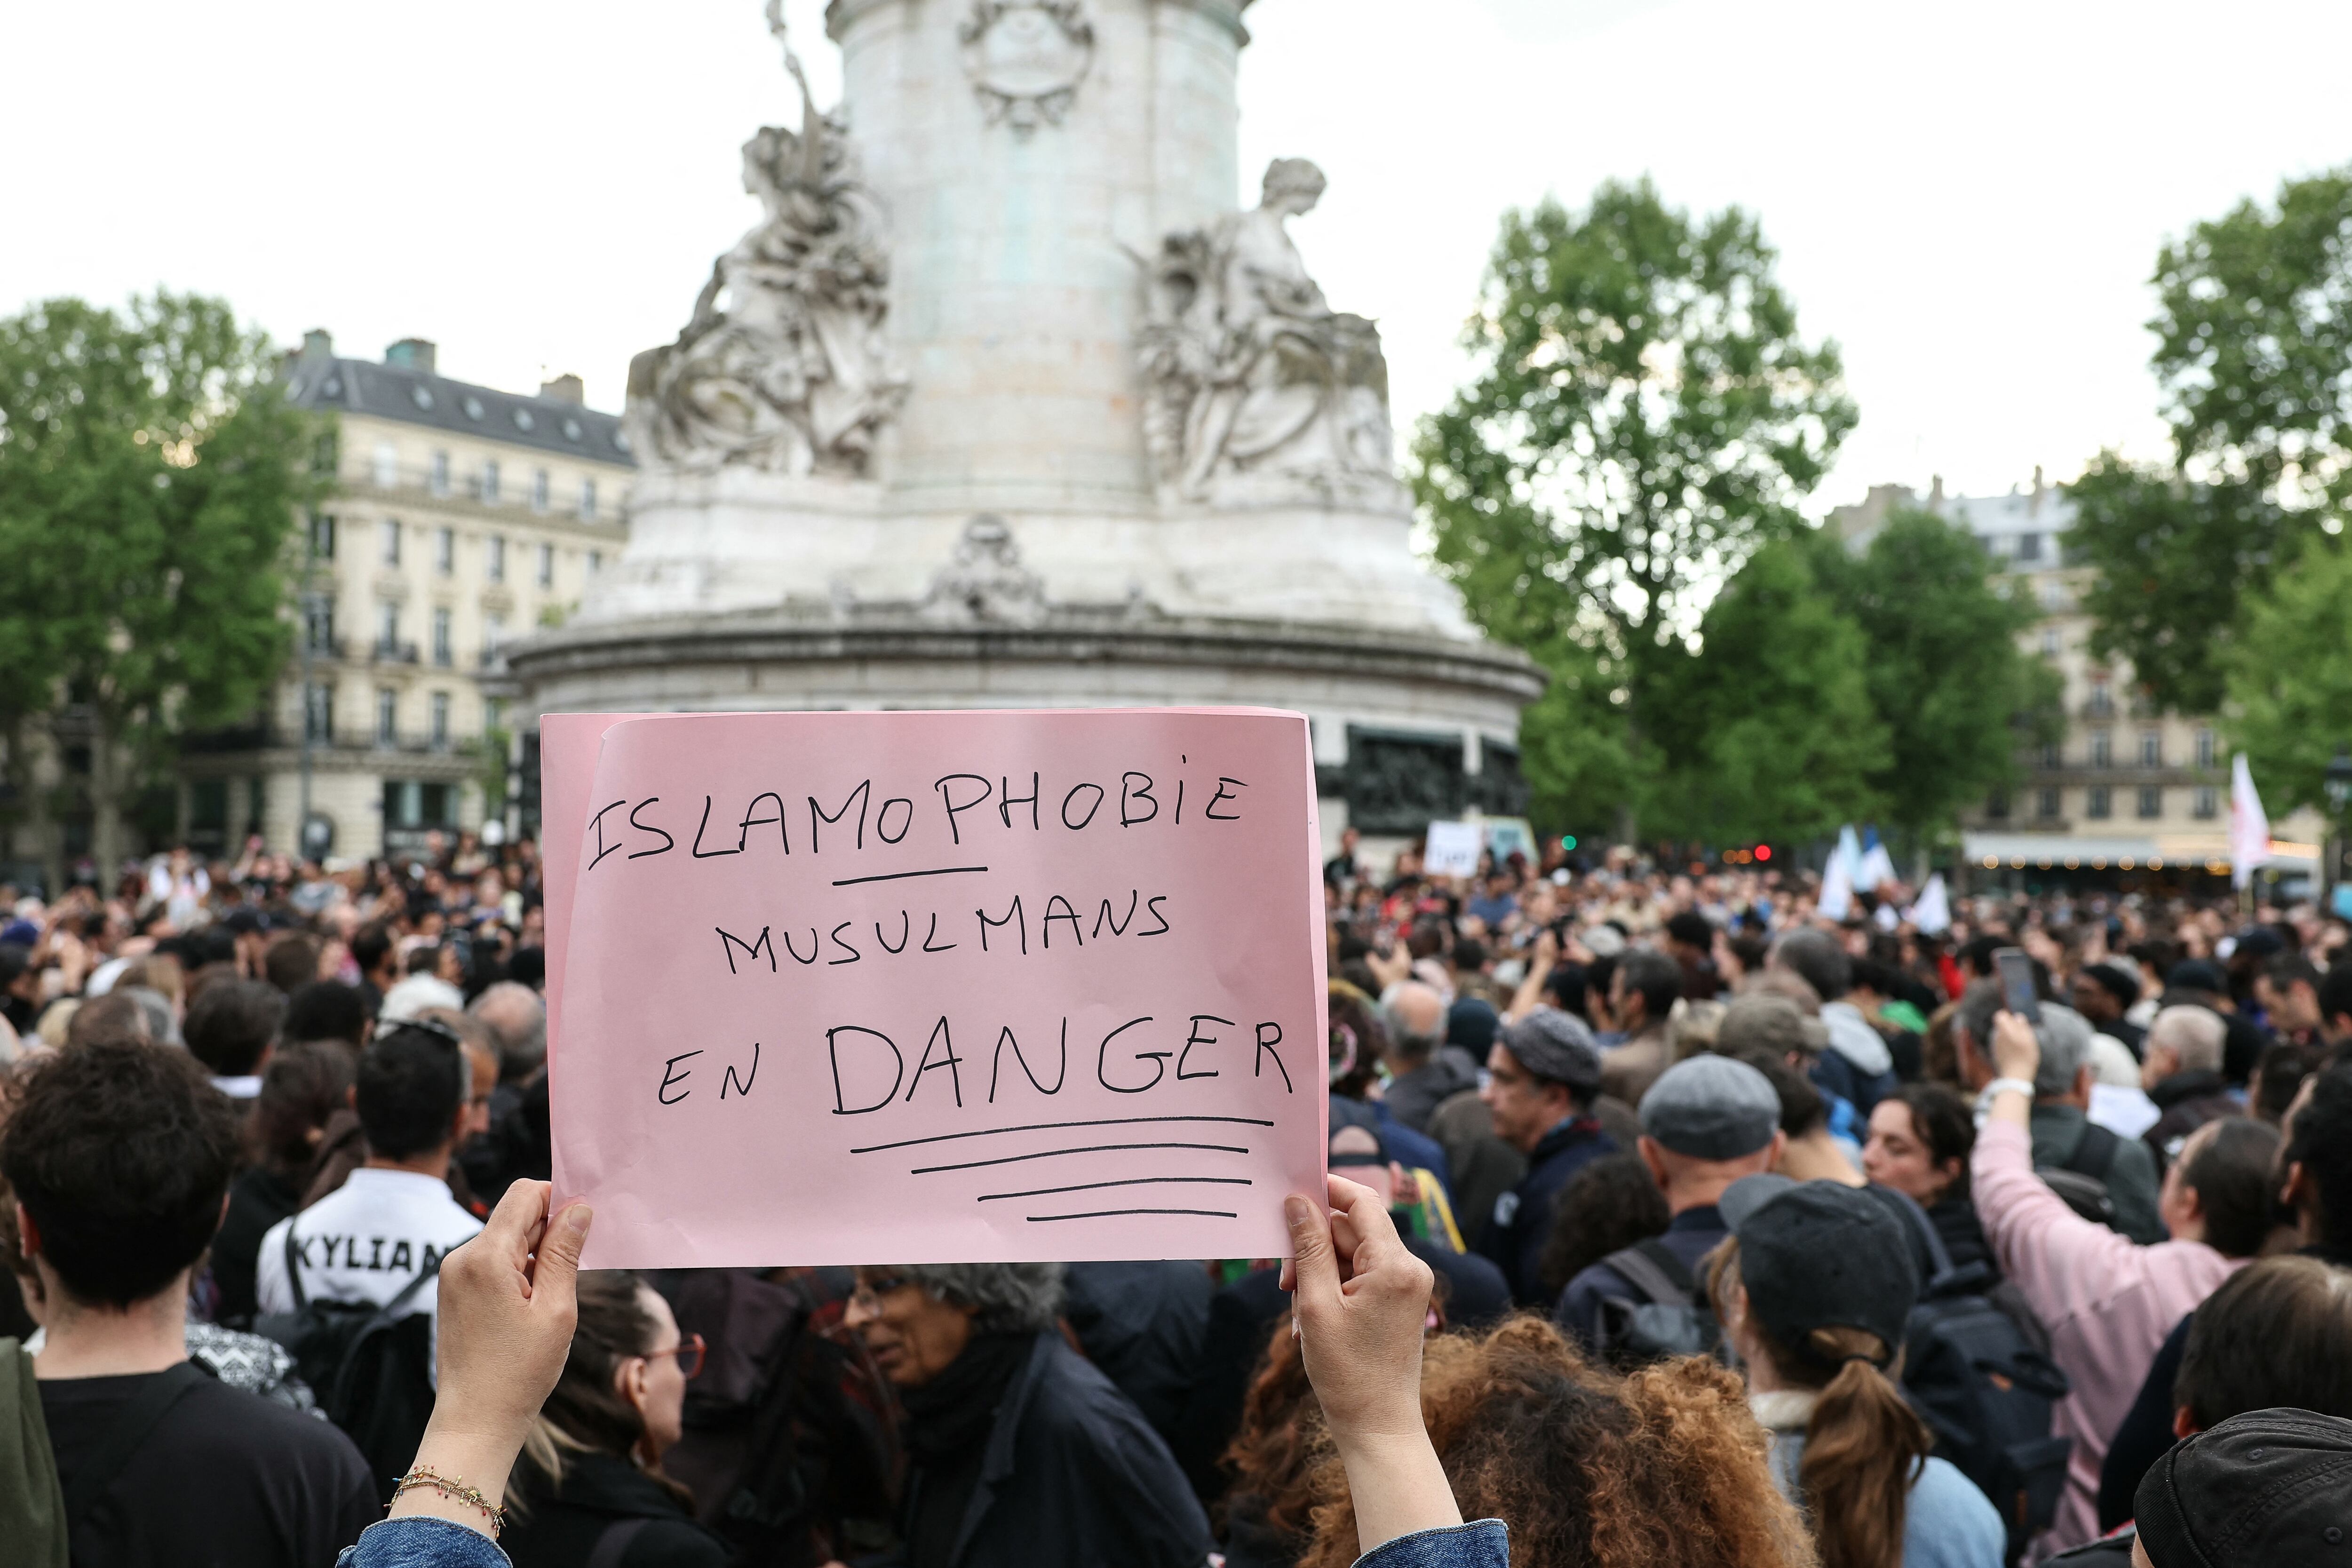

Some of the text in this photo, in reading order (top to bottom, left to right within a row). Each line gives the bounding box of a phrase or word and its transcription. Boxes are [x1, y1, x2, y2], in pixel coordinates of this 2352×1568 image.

[715, 889, 1169, 975] MUSULMANS
[658, 1015, 1293, 1115] EN DANGER
